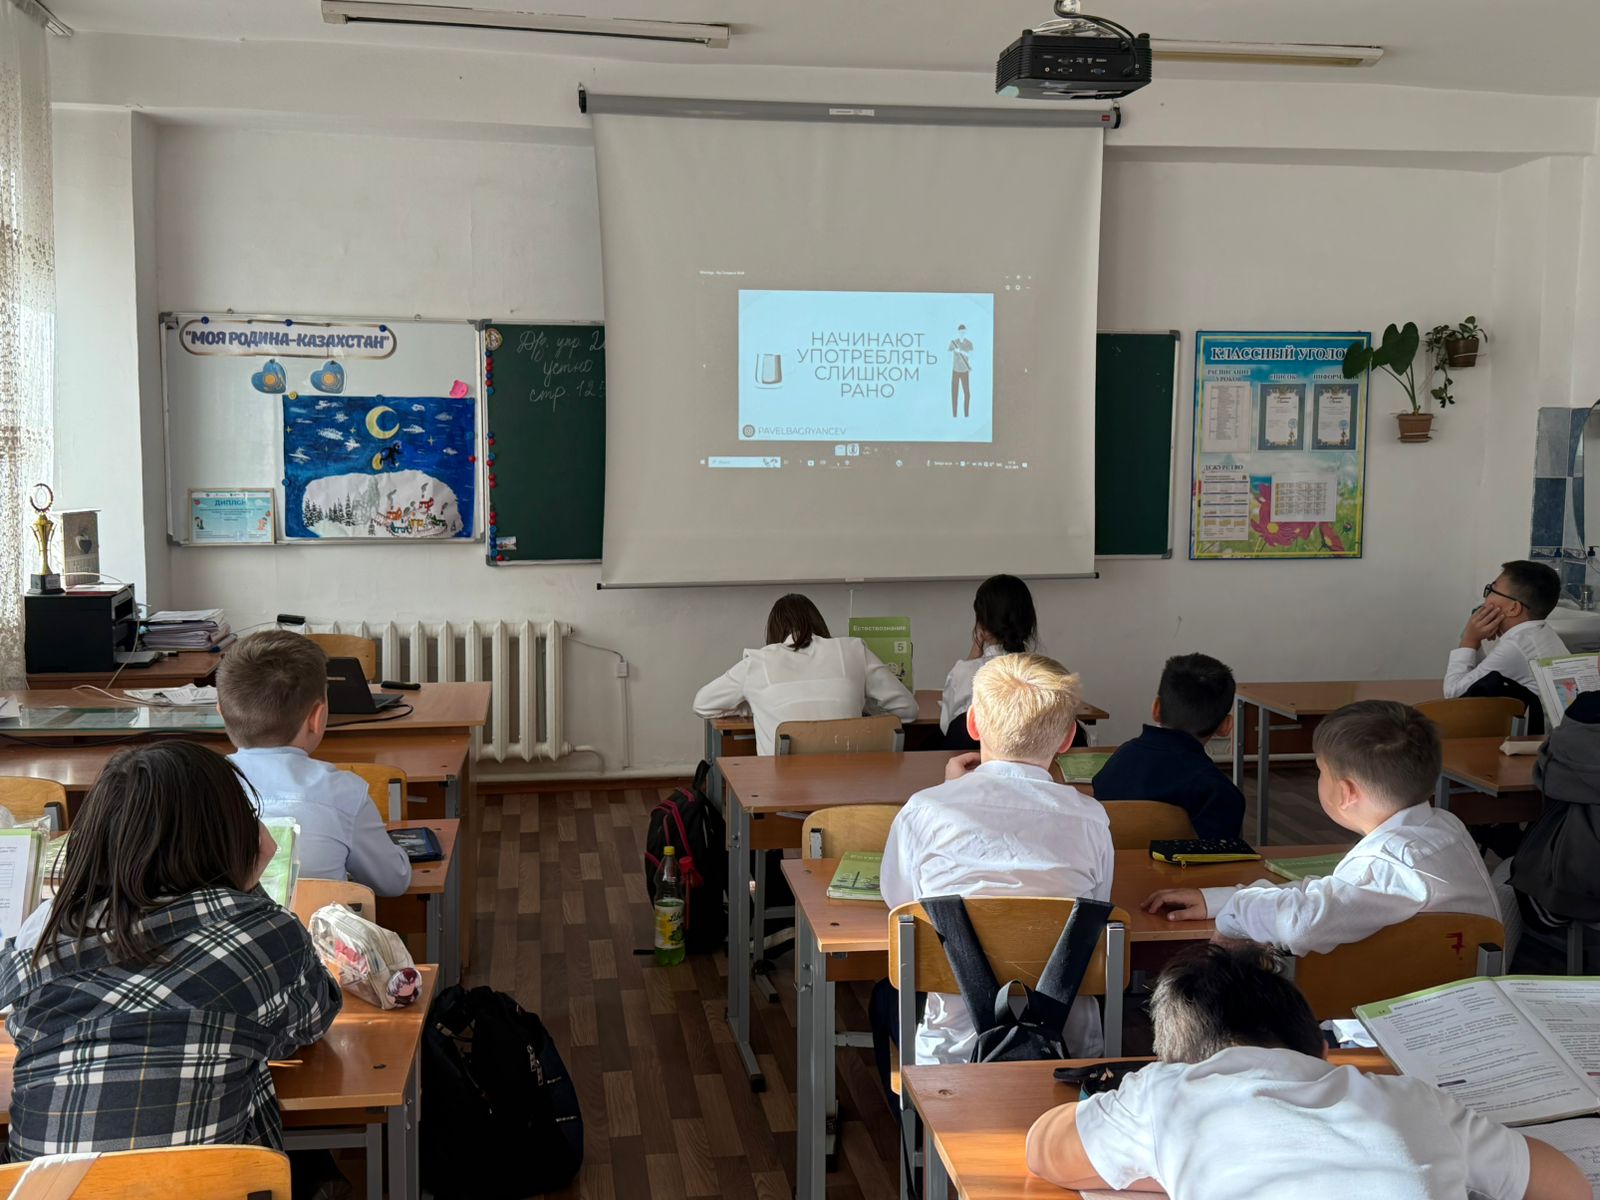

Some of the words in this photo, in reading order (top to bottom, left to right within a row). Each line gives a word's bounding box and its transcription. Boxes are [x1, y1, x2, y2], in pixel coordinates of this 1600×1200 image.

[185, 330, 226, 345] "МОЯ
[228, 331, 390, 349] РОДИНА-КАЗАХСТАН"
[811, 331, 925, 348] НАЧИНАЮТ
[797, 348, 938, 365] УПОТРЕБЛЯТЬ
[1211, 345, 1296, 361] КЛАССНЫЙ
[1298, 347, 1348, 361] УГОЛО
[814, 365, 920, 382] СЛИШКОМ
[841, 383, 895, 399] РАНО
[758, 427, 847, 436] PAVELBAGRYANCEV
[897, 642, 904, 652] 5
